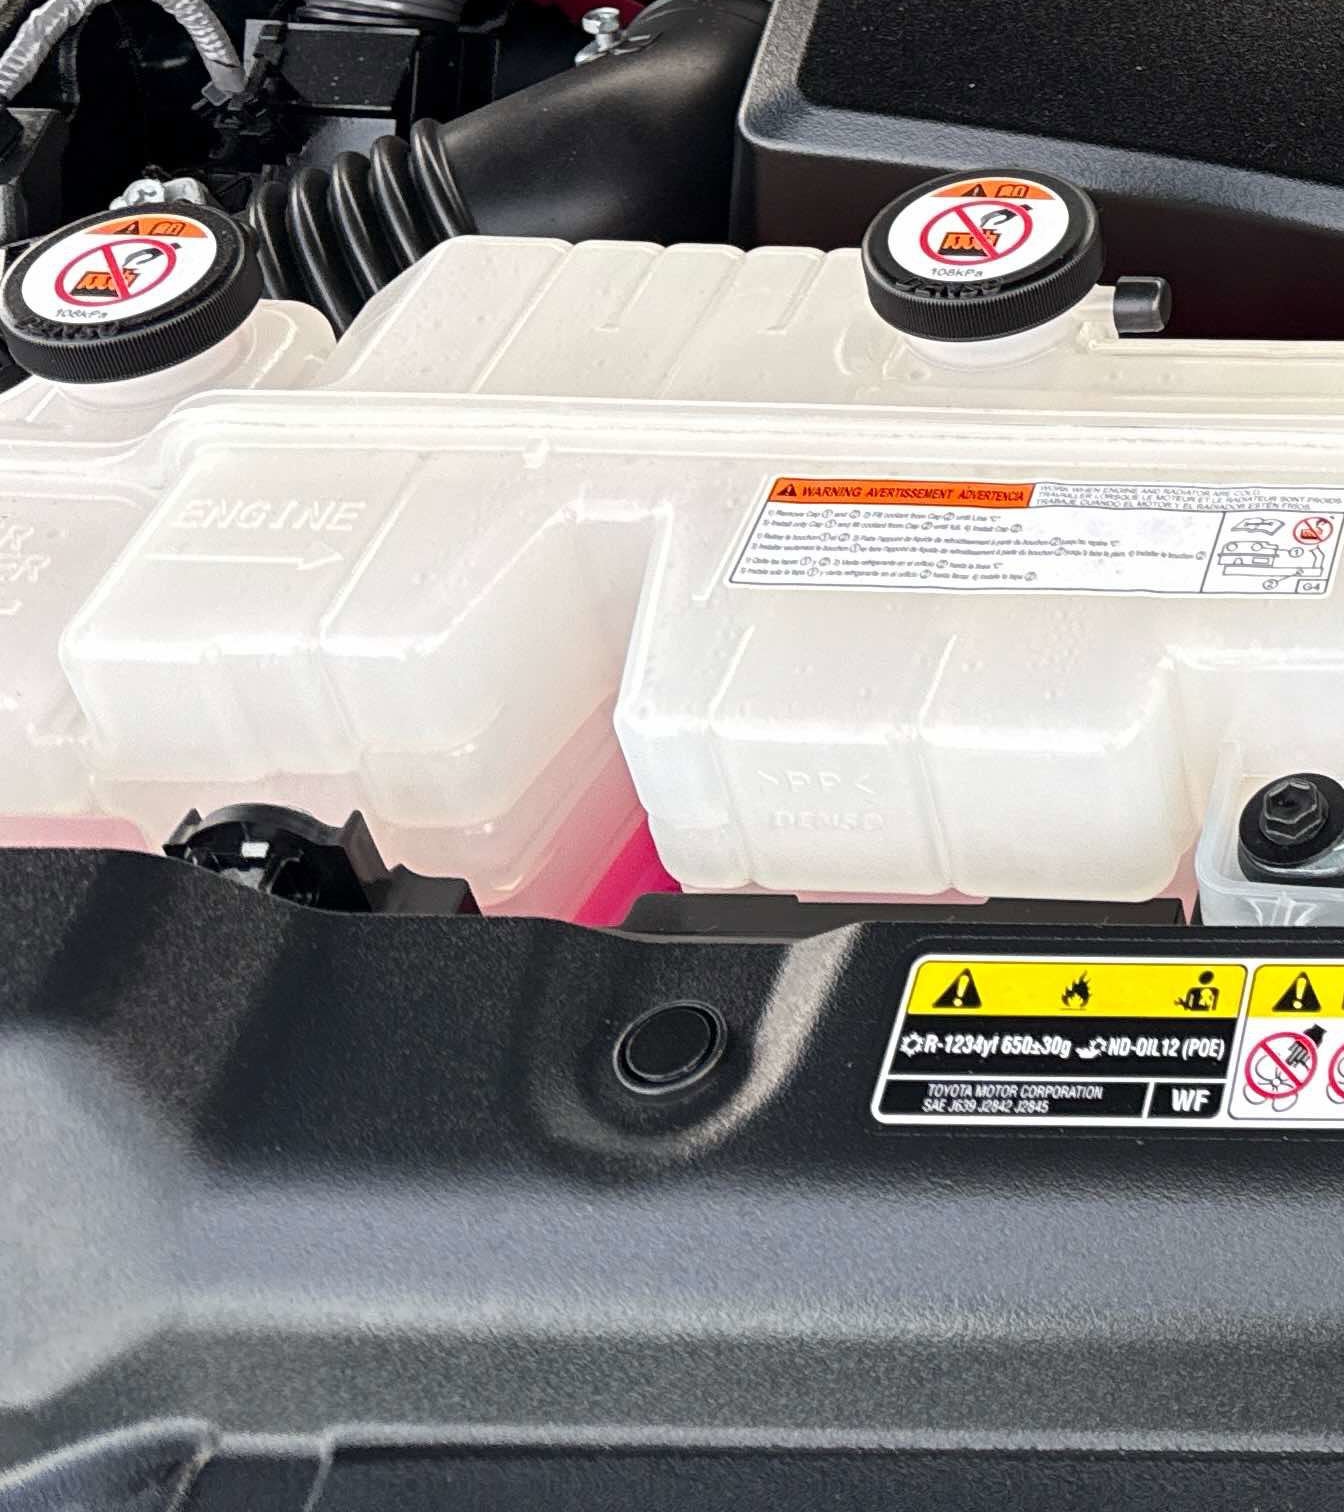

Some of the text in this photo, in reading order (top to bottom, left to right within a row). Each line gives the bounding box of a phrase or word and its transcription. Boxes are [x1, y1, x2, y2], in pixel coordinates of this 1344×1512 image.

[801, 486, 1024, 502] WARNING AVERTISSEMENT ADVERTENCIA
[170, 497, 367, 532] ENGINE
[923, 1033, 998, 1059] R-1234yf
[1001, 1033, 1072, 1059] 650±30g
[1181, 1036, 1226, 1062] (POE)
[927, 1082, 1104, 1101] TOYOTA MOTOR CORPORATION
[1170, 1087, 1211, 1113] WF
[921, 1098, 947, 1113] SAE
[948, 1099, 976, 1113] J639
